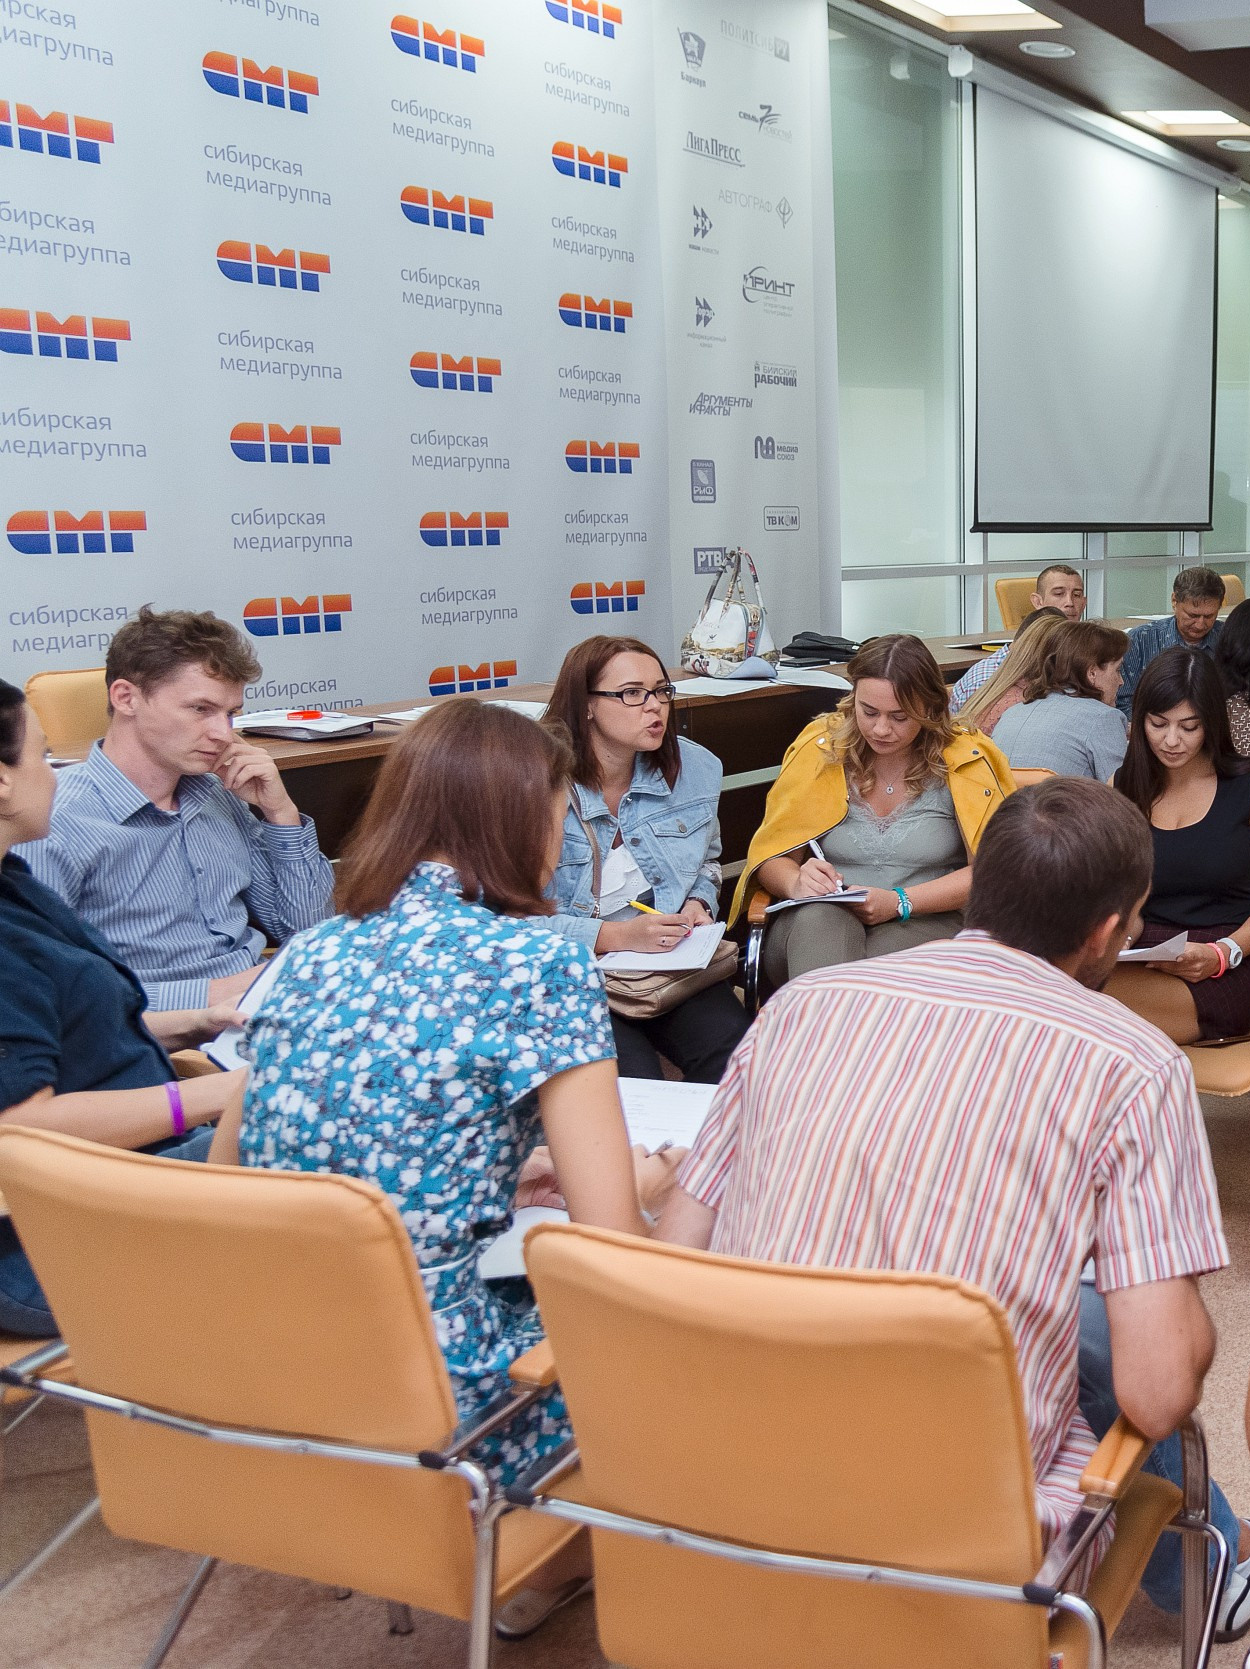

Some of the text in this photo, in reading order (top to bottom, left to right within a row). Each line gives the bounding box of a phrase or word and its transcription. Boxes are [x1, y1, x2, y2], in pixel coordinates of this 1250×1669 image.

[545, 0, 622, 40] СМГ
[0, 25, 113, 66] иагруппа
[391, 14, 485, 74] СМГ
[202, 51, 319, 114] СМГ
[544, 60, 611, 91] сибирская
[391, 98, 472, 130] сибирская
[545, 82, 630, 117] медиагруппа
[392, 121, 495, 157] медиагруппа
[204, 143, 303, 176] сибирская
[551, 140, 628, 188] СМГ
[206, 170, 332, 207] медиагруппа
[718, 188, 773, 213] АВТОГРАФ
[400, 185, 494, 236] СМГ
[551, 216, 617, 240] сибирская
[552, 237, 635, 263] медиагруппа
[216, 240, 331, 292] СМГ
[400, 267, 480, 292] сибирская
[402, 291, 503, 316] медиагруппа
[558, 293, 633, 334] СМГ
[217, 330, 314, 354] сибирская
[220, 356, 343, 381] медиагруппа
[410, 351, 502, 393] СМГ
[558, 365, 622, 384] сибирская
[559, 386, 642, 406] медиагруппа
[694, 392, 753, 408] АРГУМЕНТЫ
[0, 408, 112, 432] ибирская
[229, 422, 342, 465] СМГ
[410, 429, 489, 449] сибирская
[412, 454, 510, 473] медиагруппа
[565, 439, 641, 474] СМГ
[6, 510, 147, 554] СМГ
[230, 507, 326, 528] сибирская
[419, 511, 509, 547] СМГ
[564, 509, 629, 526] сибирская
[233, 532, 353, 553] медиагруппа
[565, 530, 647, 546] медиагруппа
[420, 587, 496, 606] сибирская
[570, 580, 646, 615] СМГ
[9, 604, 129, 627] сибирская
[243, 594, 352, 637] СМГ
[421, 607, 518, 627] медиагруппа
[245, 679, 337, 699] сибирская
[429, 660, 518, 697] СМГ
